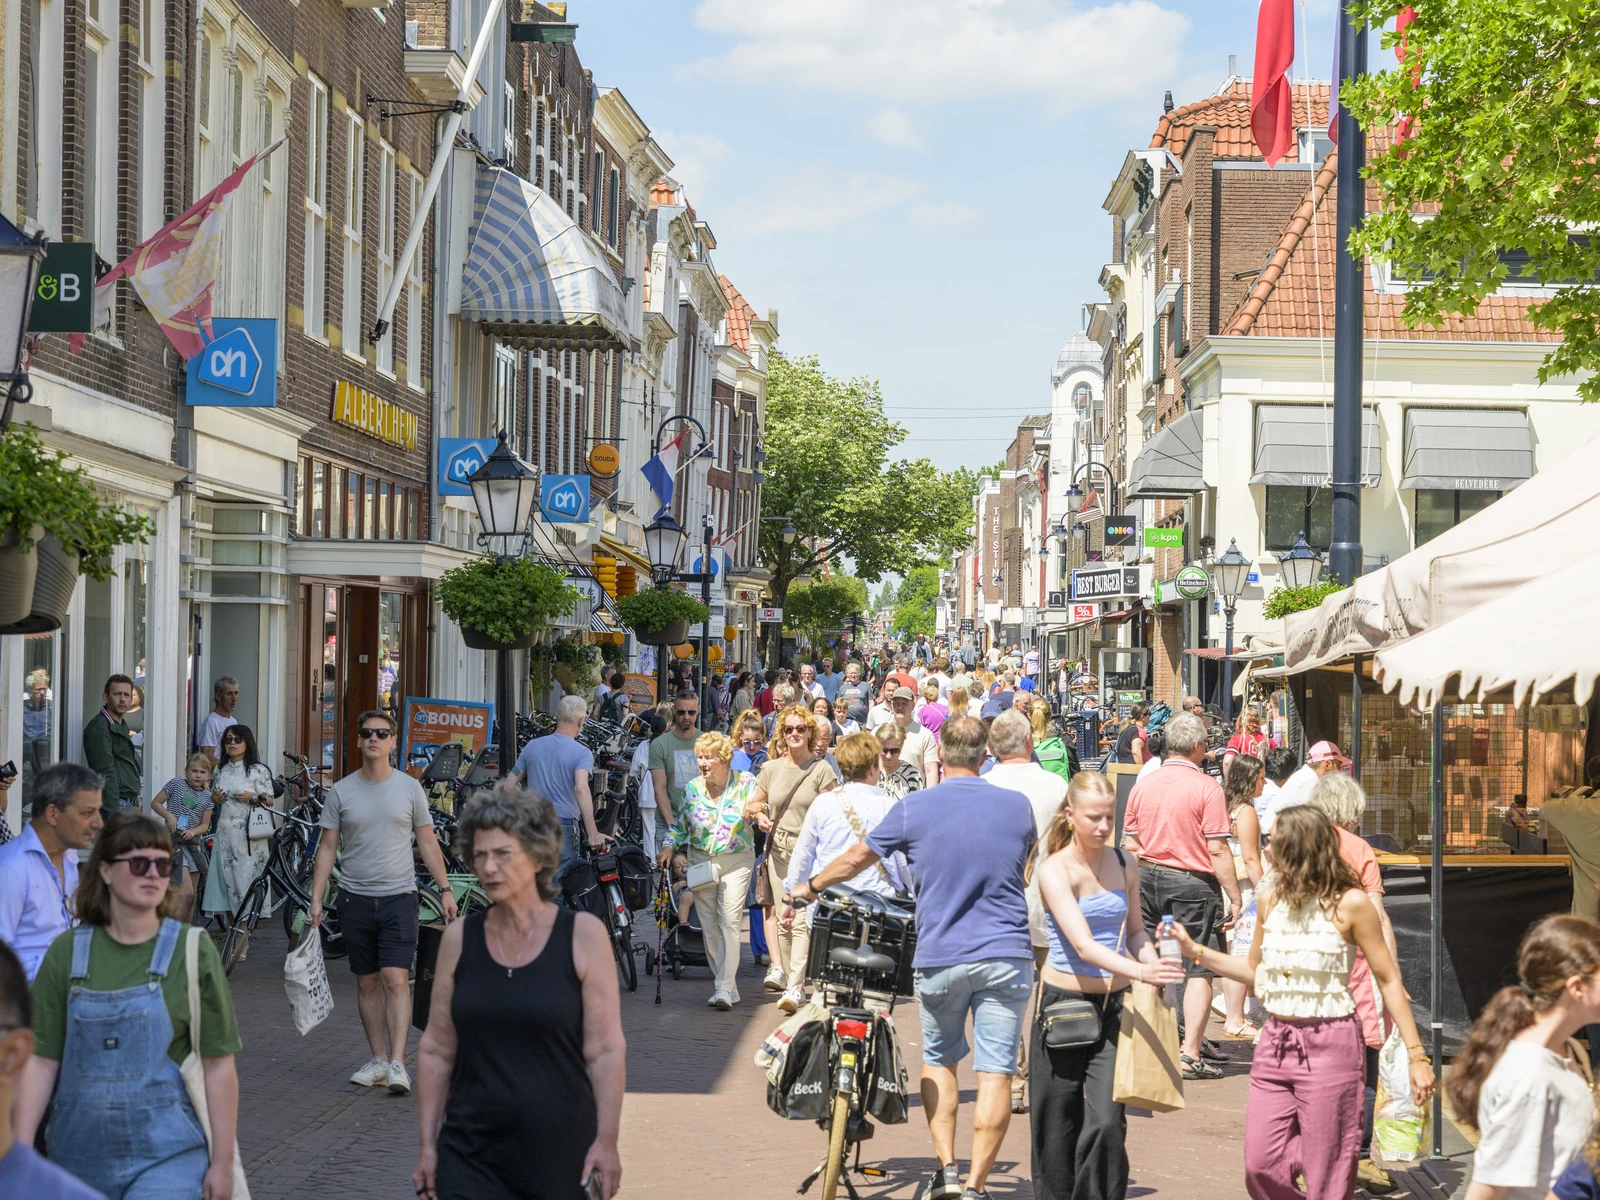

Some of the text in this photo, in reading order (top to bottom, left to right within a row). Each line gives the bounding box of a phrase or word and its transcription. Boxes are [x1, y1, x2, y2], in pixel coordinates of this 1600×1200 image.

[343, 381, 389, 438] ALBERT
[594, 455, 615, 463] GOUDA
[1455, 478, 1499, 489] BELVEDÈRE
[1161, 534, 1178, 543] kpn
[1077, 573, 1120, 595] BEST BURGER
[428, 711, 484, 729] BONUS
